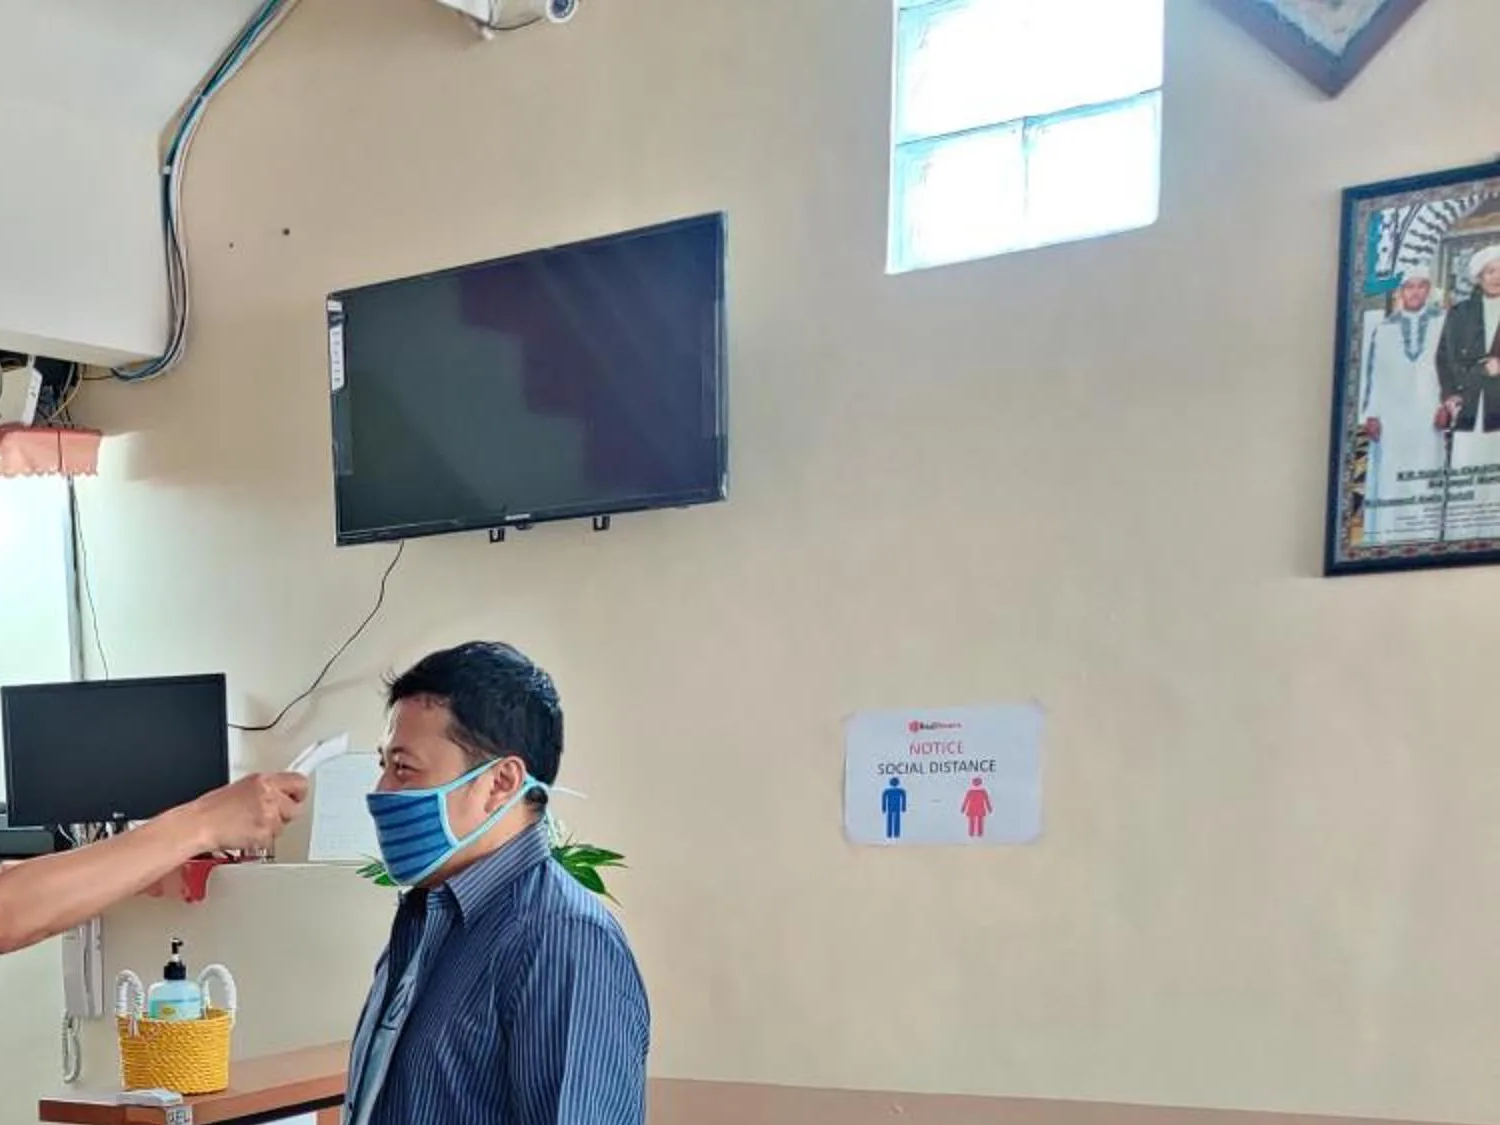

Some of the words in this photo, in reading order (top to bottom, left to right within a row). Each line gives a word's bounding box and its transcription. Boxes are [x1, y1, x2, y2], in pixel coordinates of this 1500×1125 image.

[909, 740, 964, 756] NOTICE
[877, 762, 925, 775] SOCIAL
[929, 759, 997, 774] DISTANCE
